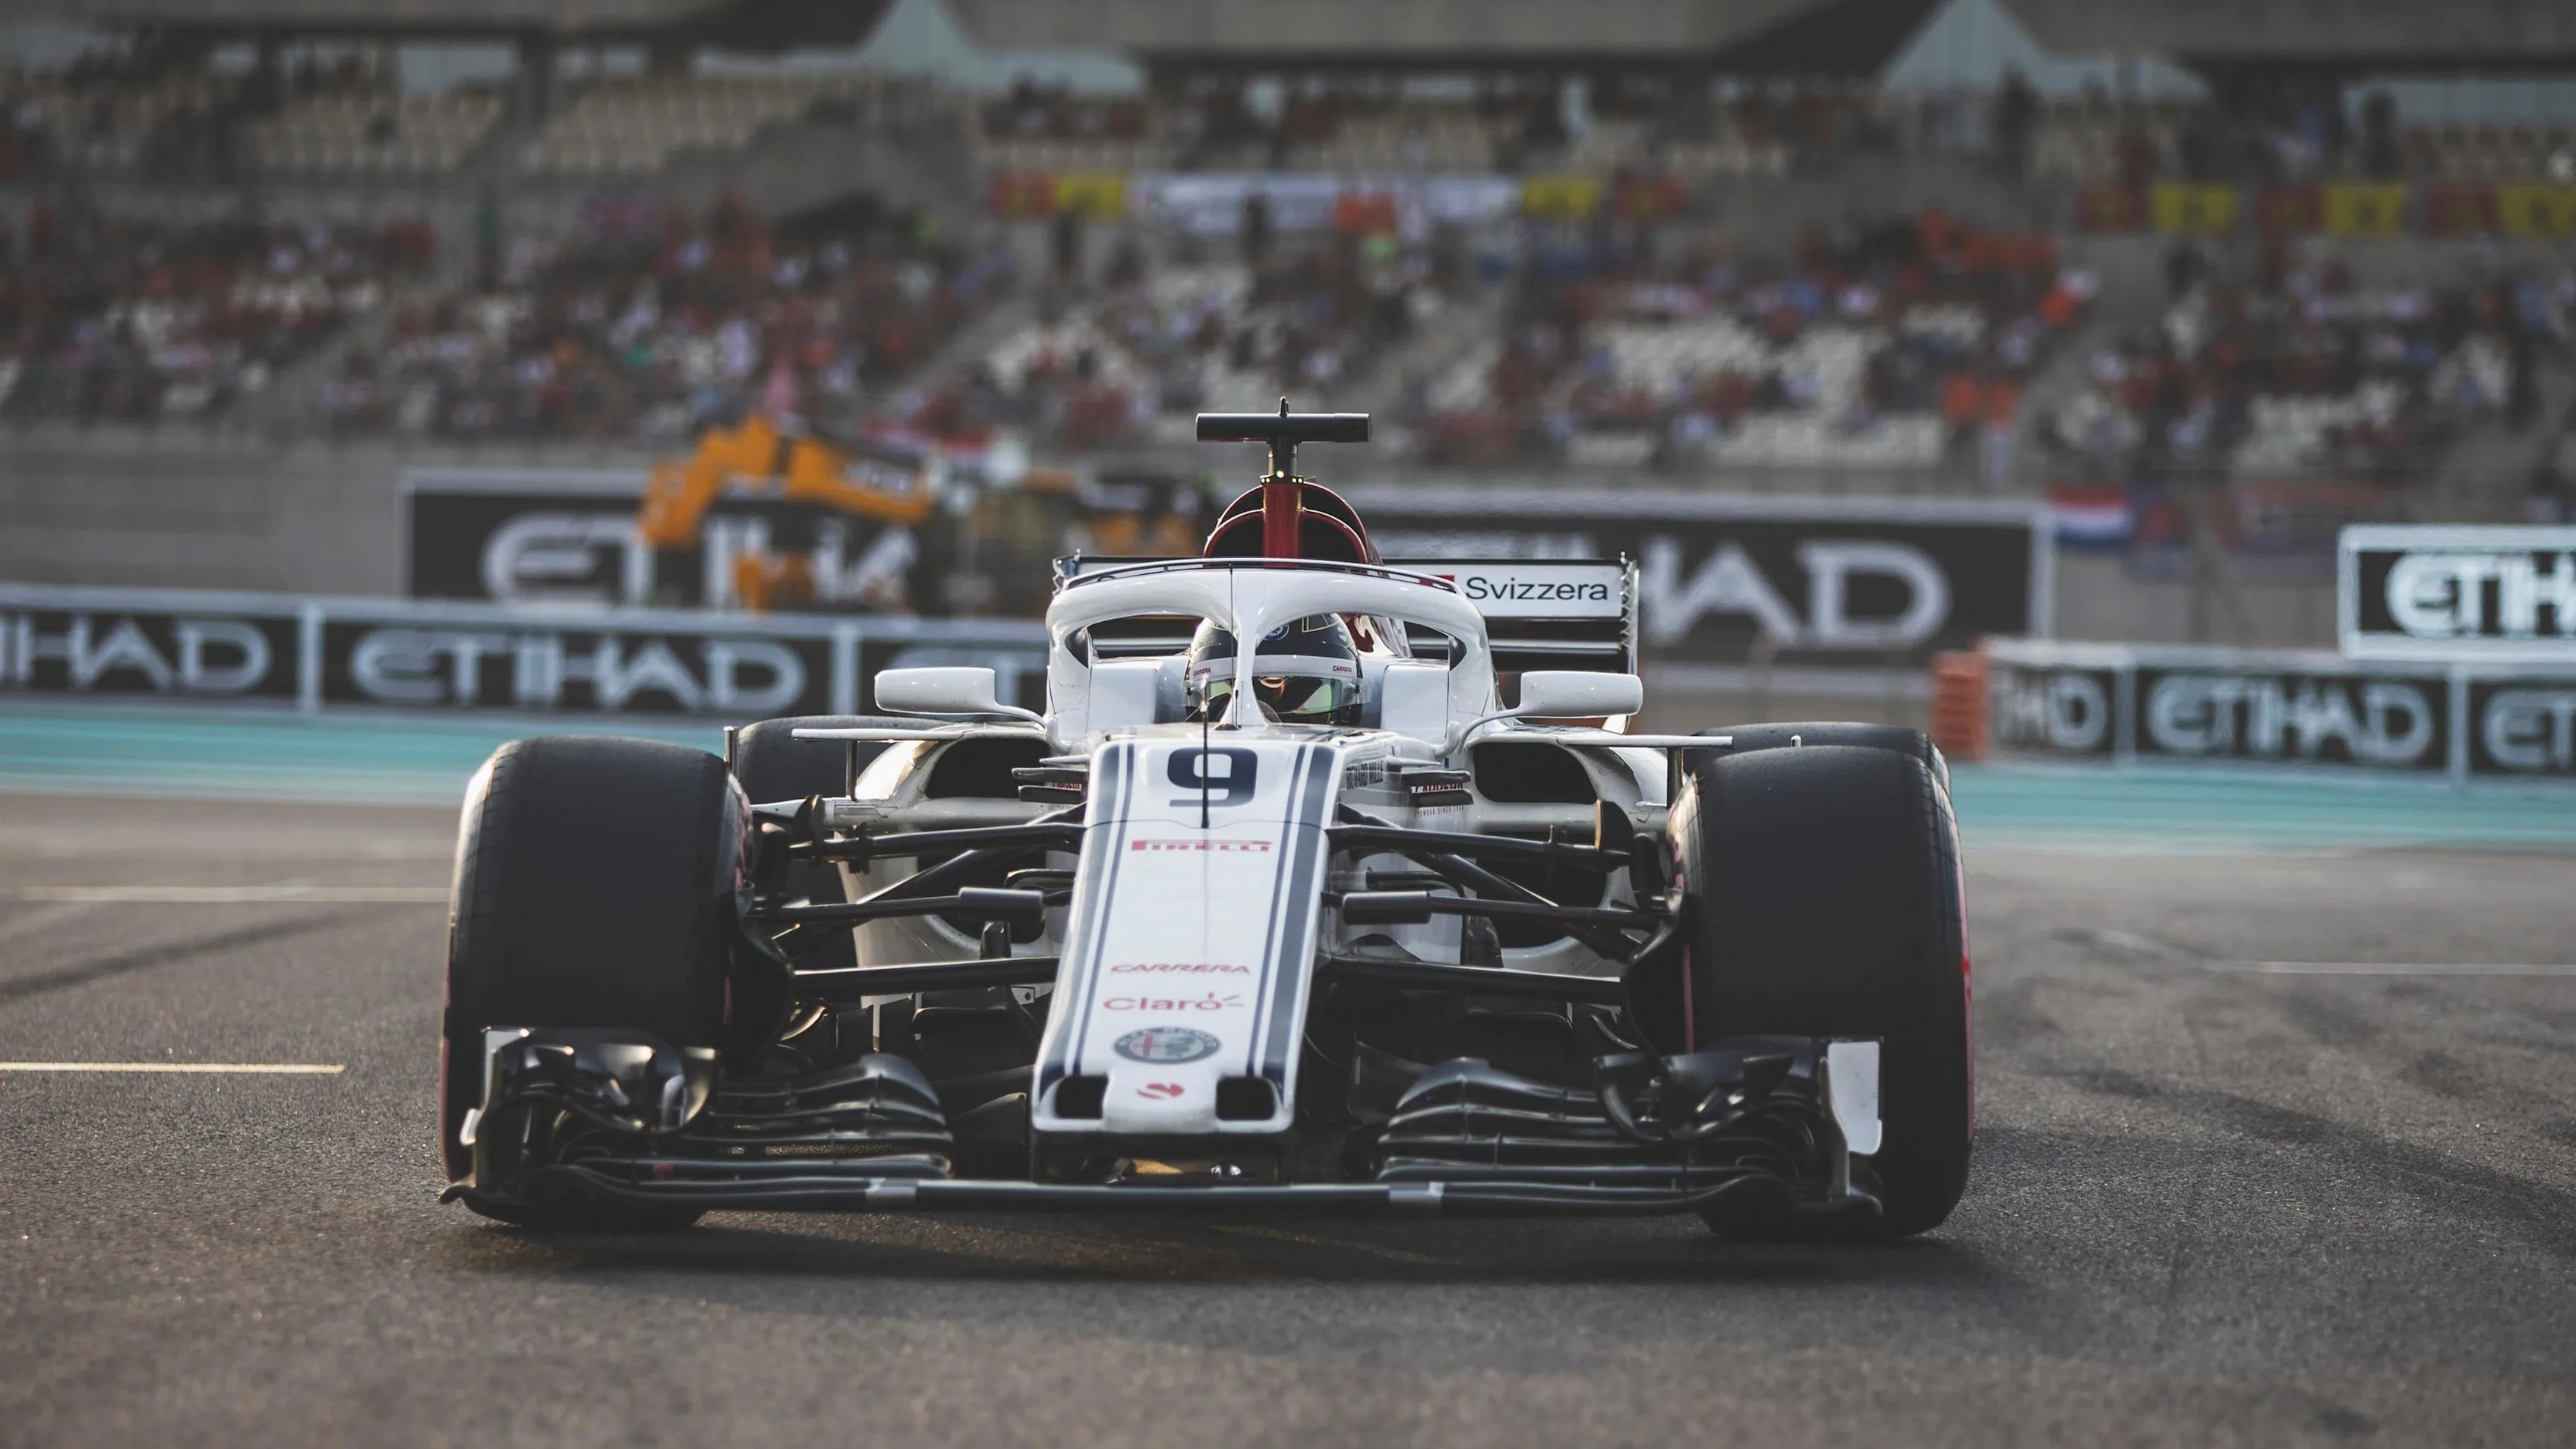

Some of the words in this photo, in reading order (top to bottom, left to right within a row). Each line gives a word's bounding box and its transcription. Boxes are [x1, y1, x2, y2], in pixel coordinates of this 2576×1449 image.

[1466, 576, 1608, 601] Svizzera
[349, 627, 808, 712] ETIHAD
[2145, 673, 2433, 760] ETIHAD
[1167, 747, 1258, 808] 9
[1132, 839, 1272, 852] PIRELLI
[1110, 964, 1250, 974] CARRERA
